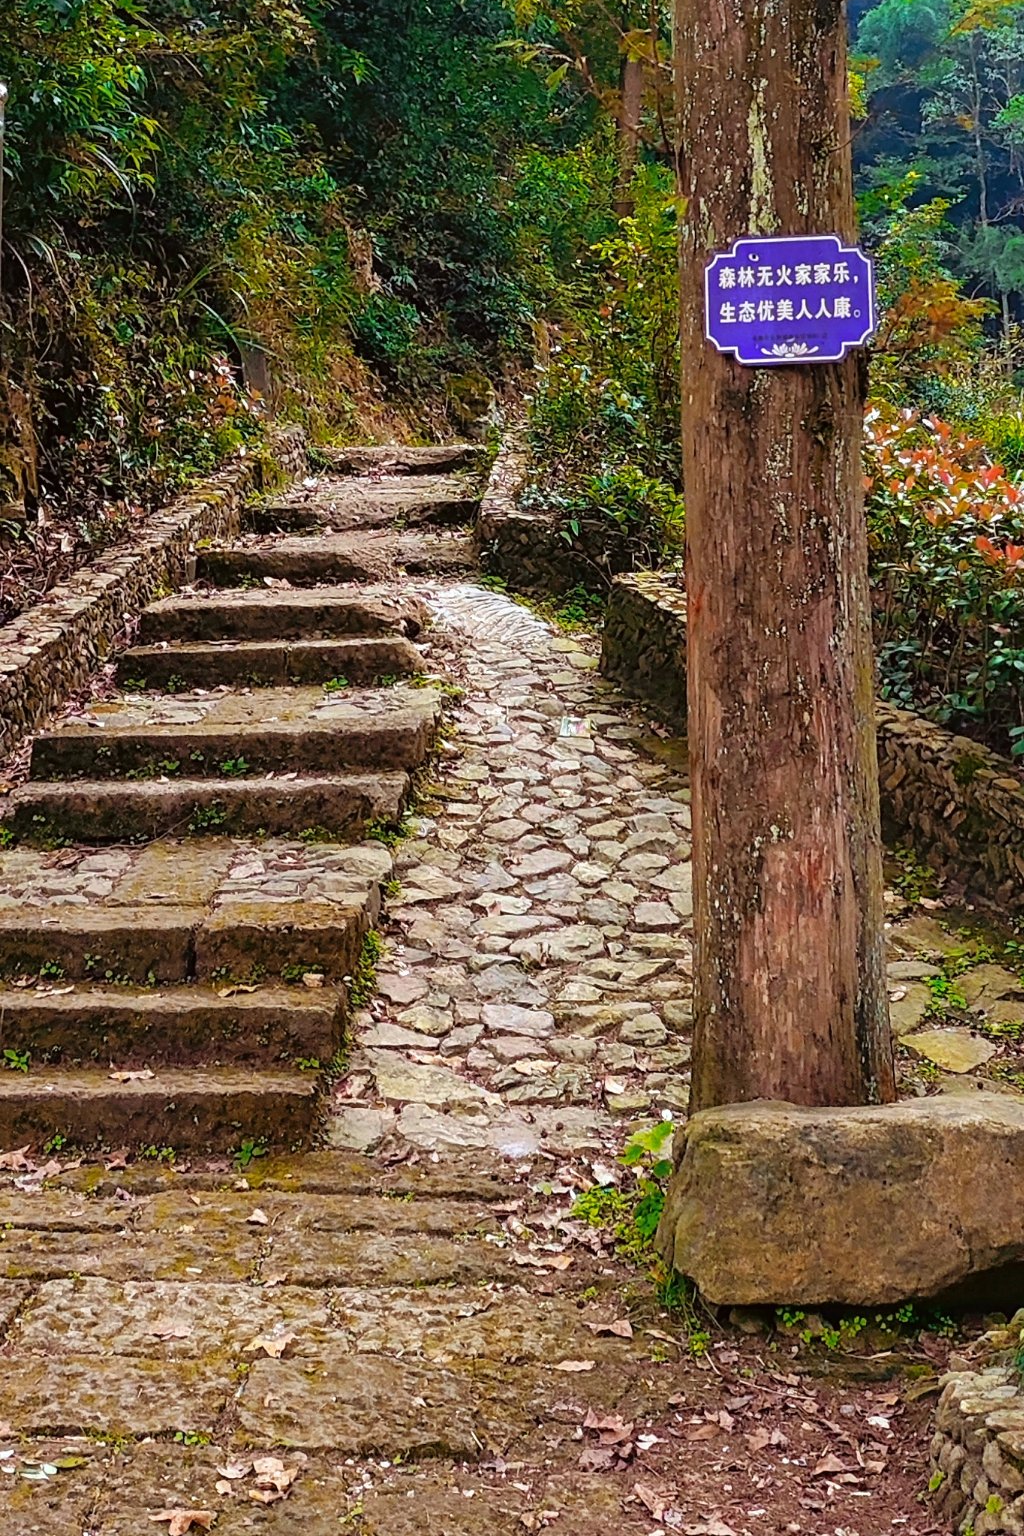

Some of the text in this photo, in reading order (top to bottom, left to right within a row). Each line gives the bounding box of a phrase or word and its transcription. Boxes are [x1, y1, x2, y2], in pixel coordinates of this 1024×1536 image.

[718, 262, 860, 290] 森林无火家家乐，
[719, 296, 861, 324] 生态优美人人康。
